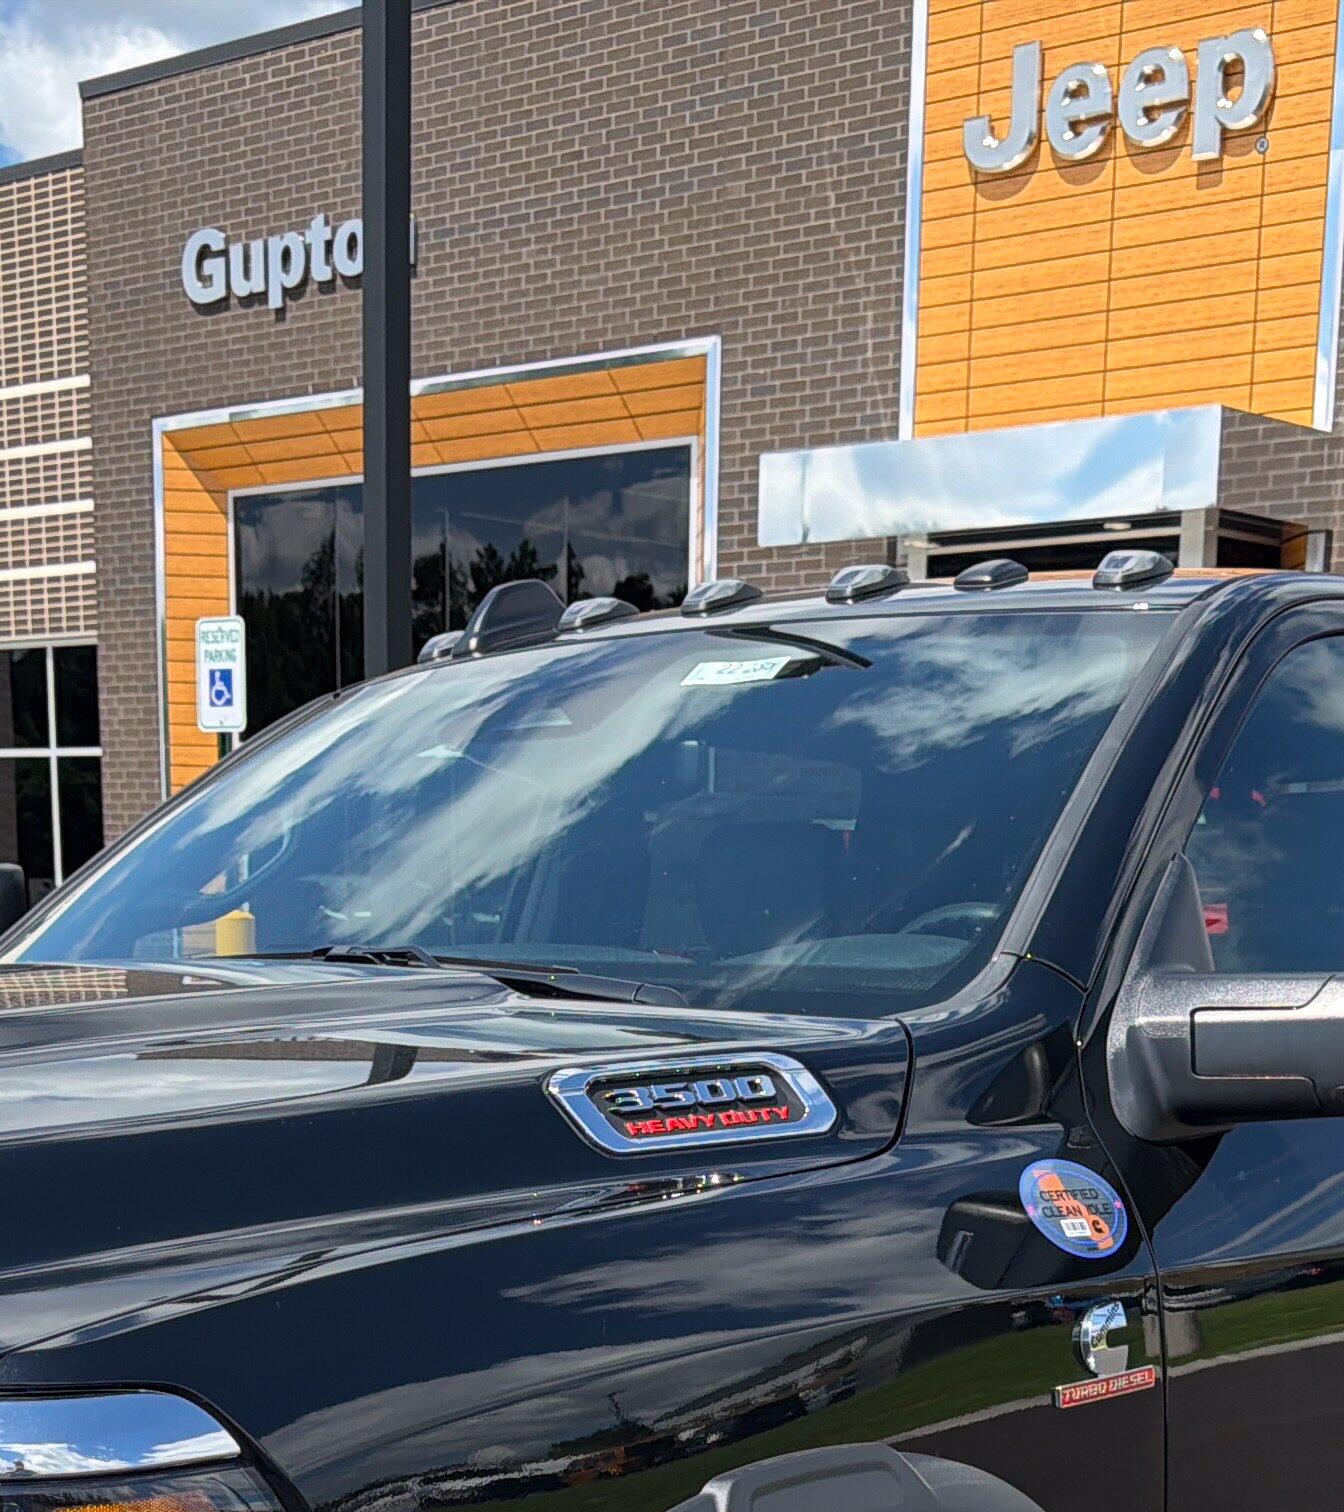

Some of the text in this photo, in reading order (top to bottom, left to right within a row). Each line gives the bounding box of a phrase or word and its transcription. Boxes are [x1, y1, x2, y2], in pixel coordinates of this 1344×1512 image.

[963, 27, 1275, 173] Jeep
[182, 213, 414, 310] Gupto
[604, 1075, 777, 1113] 3500
[625, 1106, 789, 1136] HEAVY DUTY
[1039, 1188, 1099, 1202] CERTIFIED
[1042, 1205, 1084, 1218] CLEAN
[1090, 1301, 1121, 1348] Cummins
[1062, 1371, 1153, 1402] TURBO DIESEL
